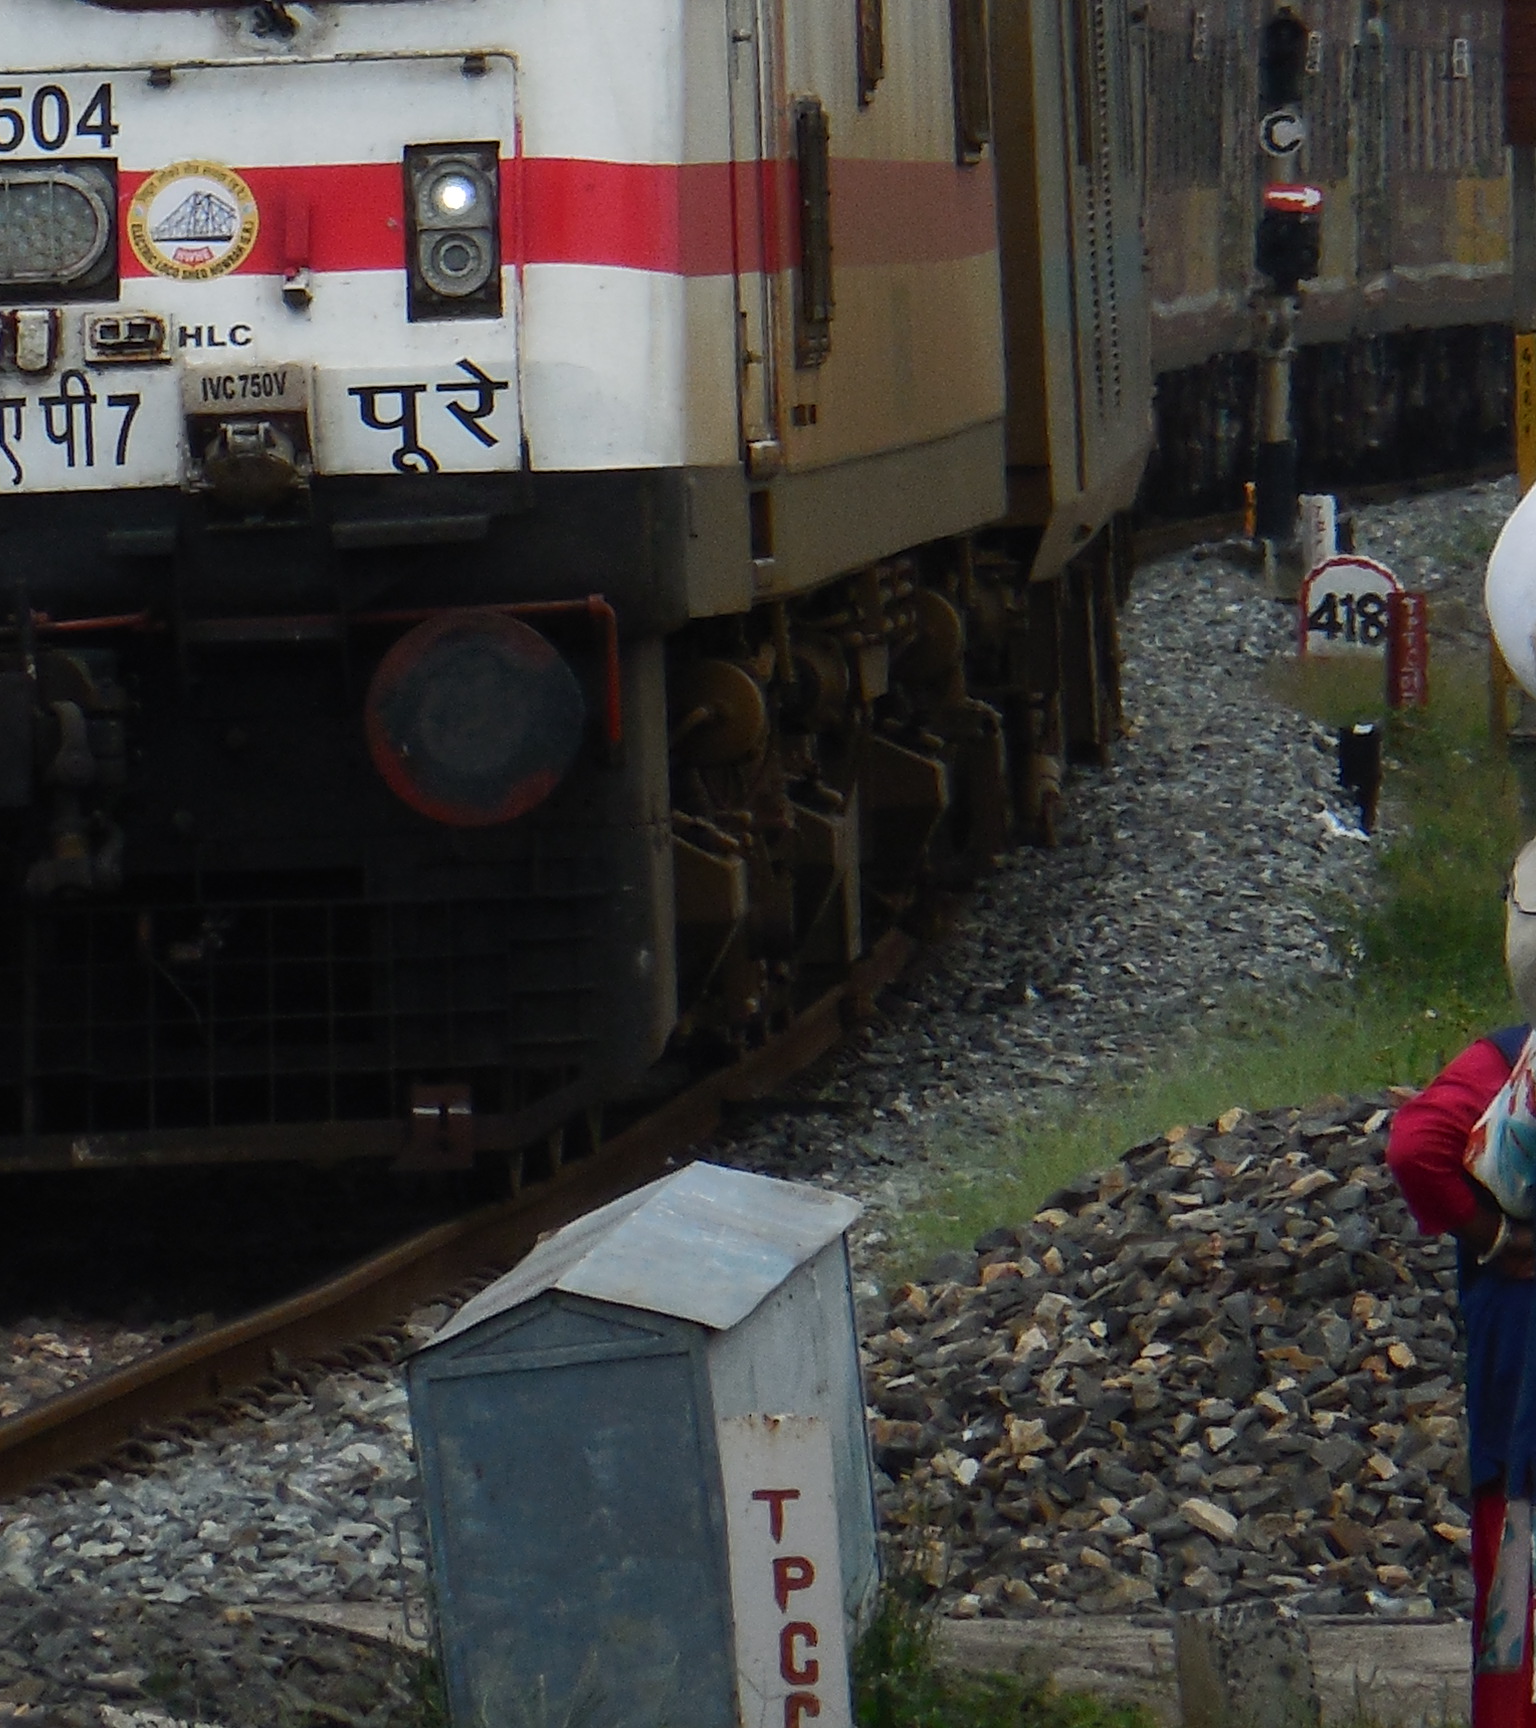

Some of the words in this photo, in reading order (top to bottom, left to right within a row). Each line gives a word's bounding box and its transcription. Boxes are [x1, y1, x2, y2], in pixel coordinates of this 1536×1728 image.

[1264, 115, 1301, 153] C
[178, 325, 253, 348] HLC
[1308, 591, 1391, 646] 418
